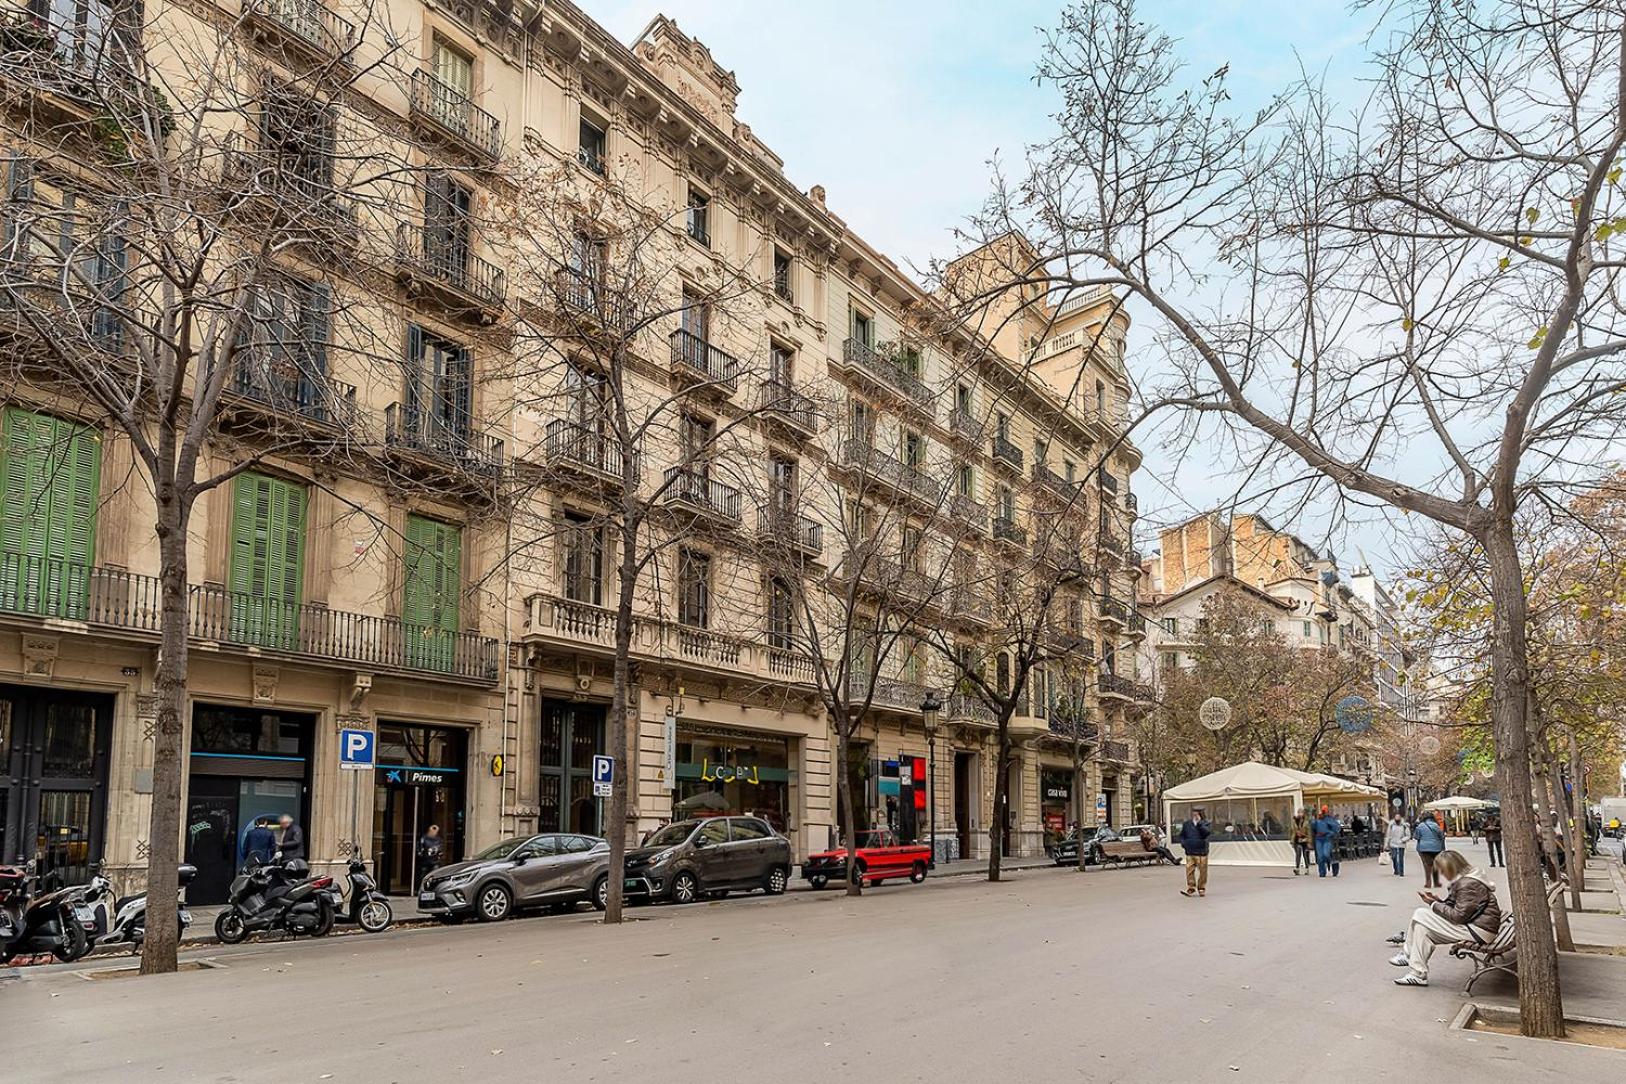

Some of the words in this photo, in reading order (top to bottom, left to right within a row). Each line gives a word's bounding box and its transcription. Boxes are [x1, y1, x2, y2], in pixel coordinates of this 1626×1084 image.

[347, 733, 368, 760] P
[412, 772, 443, 783] Pimes
[597, 759, 610, 780] P
